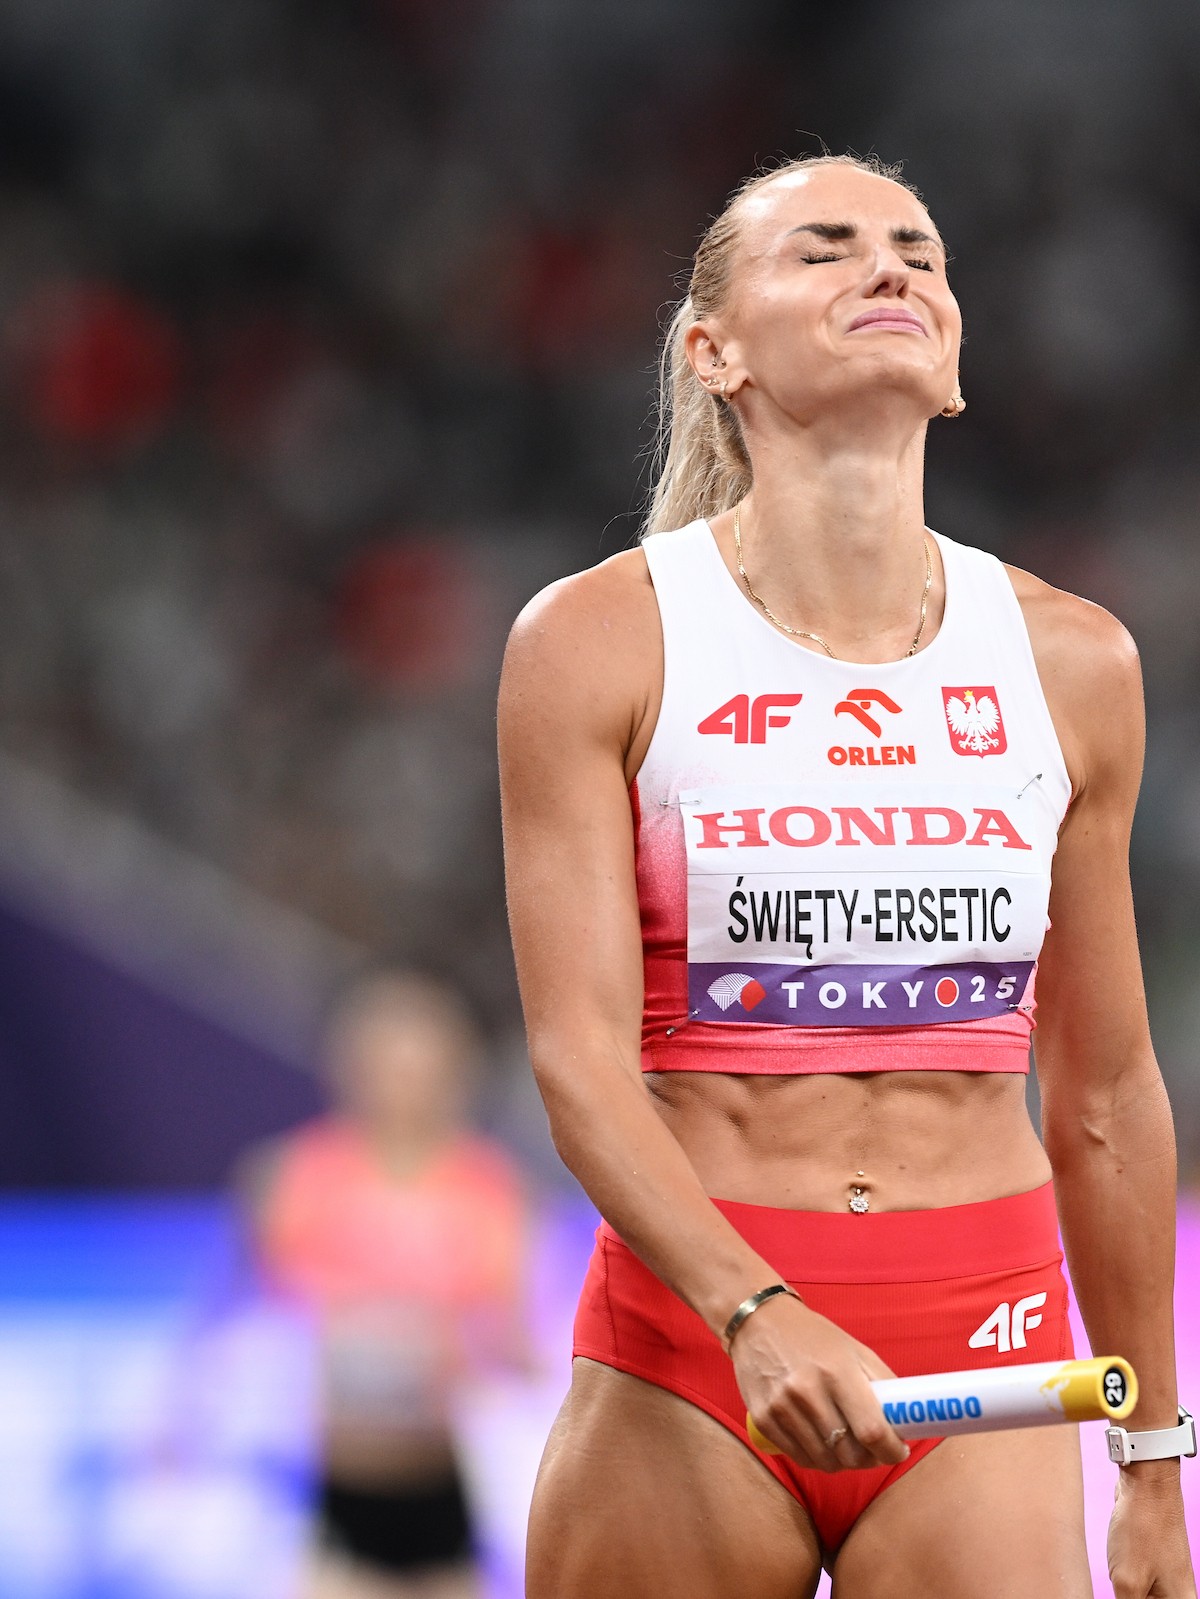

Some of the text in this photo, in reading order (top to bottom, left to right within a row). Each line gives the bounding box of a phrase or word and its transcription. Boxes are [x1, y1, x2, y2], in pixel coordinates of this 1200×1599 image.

[697, 694, 803, 744] 4F
[827, 745, 916, 766] ORLEN
[692, 806, 1032, 850] HONDA
[727, 876, 1012, 959] ŚWIĘTY-ERSETIC
[967, 1292, 1047, 1353] 4F
[1105, 1372, 1123, 1402] 29
[883, 1396, 982, 1425] MONDO
